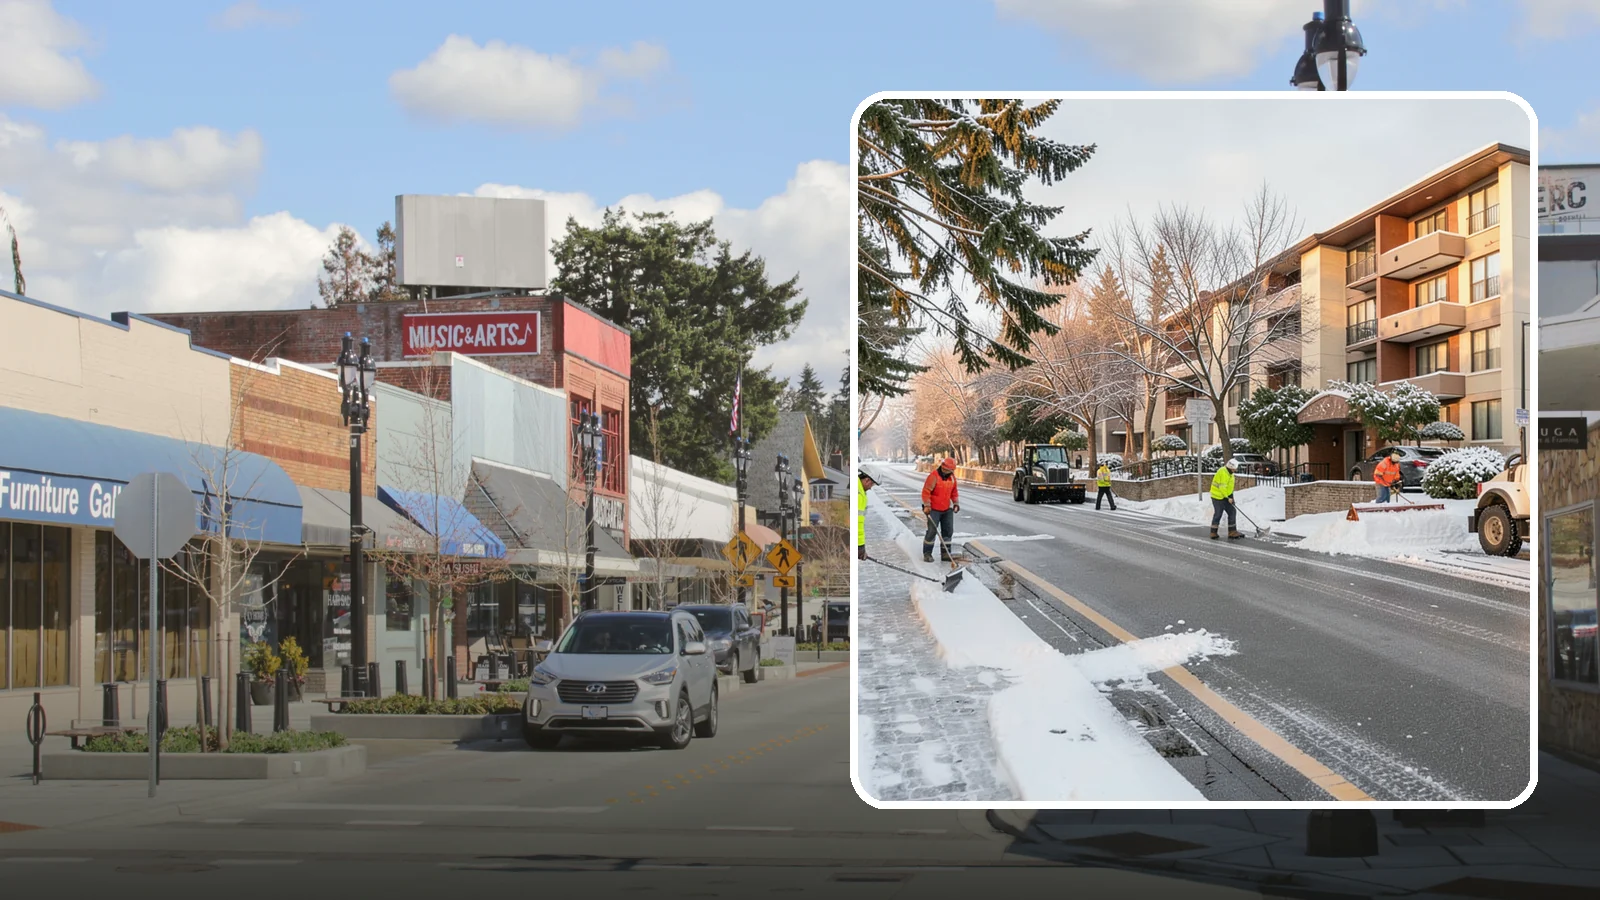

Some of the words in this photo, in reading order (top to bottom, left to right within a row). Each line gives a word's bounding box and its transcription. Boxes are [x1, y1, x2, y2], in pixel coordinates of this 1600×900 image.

[409, 323, 519, 348] MUSIC&ARTS
[1540, 427, 1577, 436] UGA
[0, 472, 79, 515] Furniture
[453, 563, 479, 574] SUSHI
